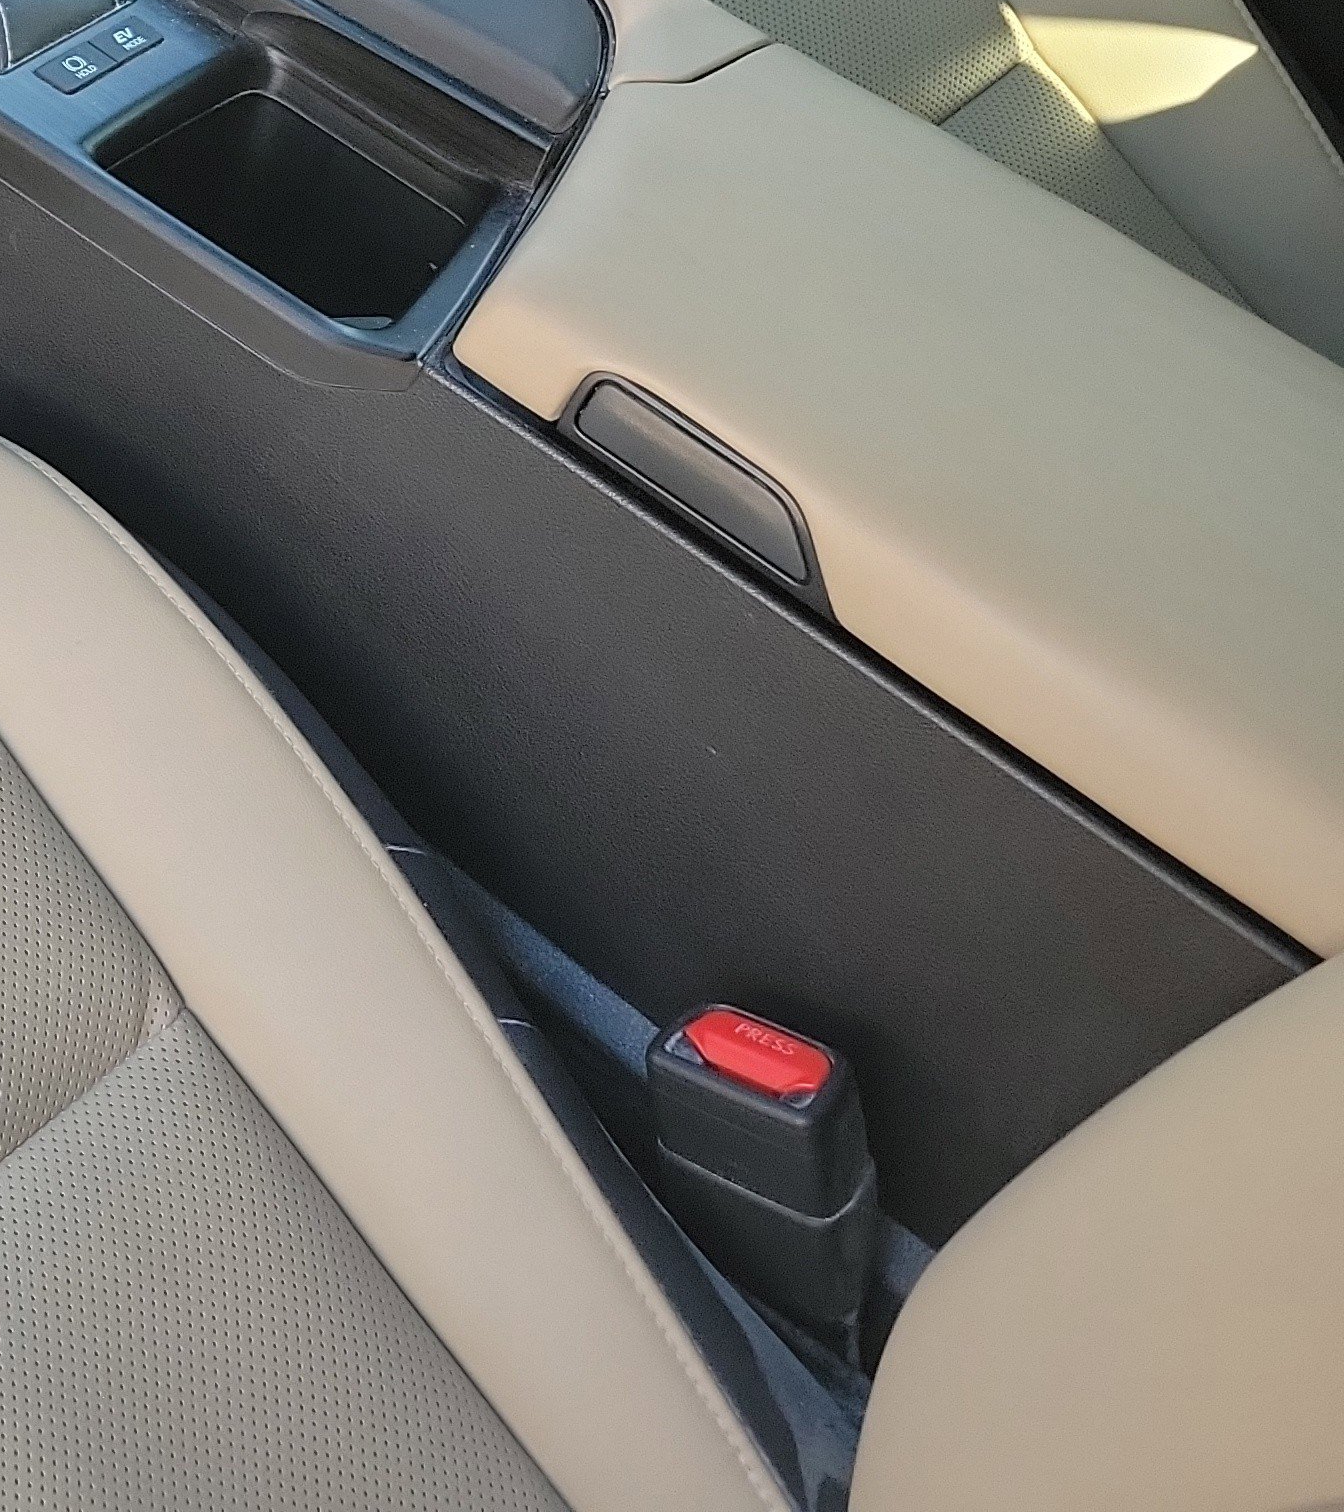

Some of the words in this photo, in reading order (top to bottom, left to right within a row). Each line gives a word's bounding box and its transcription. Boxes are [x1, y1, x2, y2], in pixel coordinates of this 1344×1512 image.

[112, 26, 133, 44] EV
[122, 35, 147, 51] MODE
[75, 64, 98, 80] HOLD
[734, 1022, 795, 1056] PRESS
